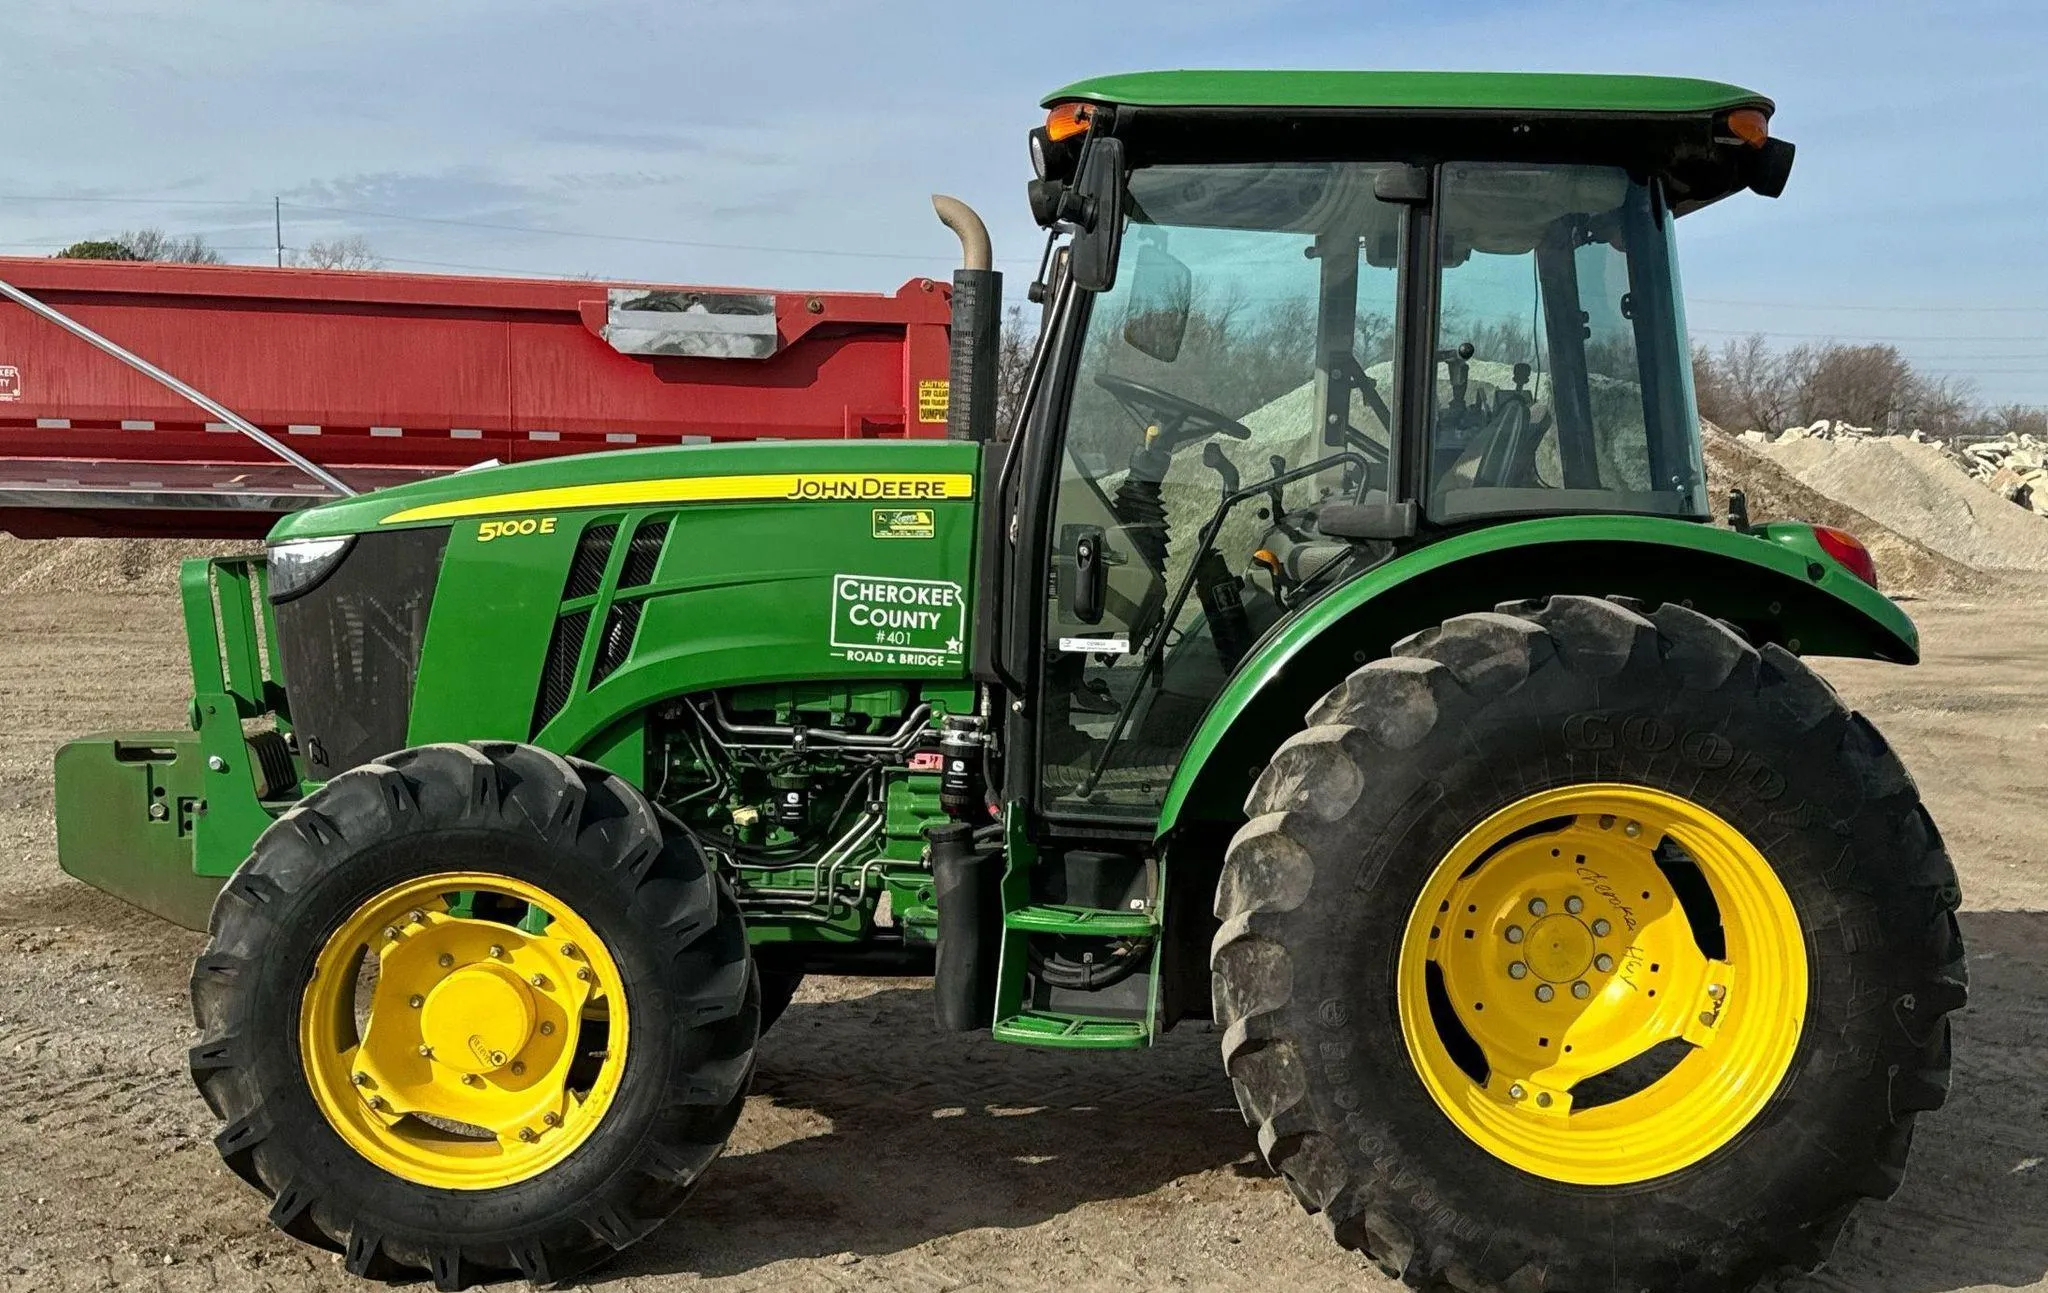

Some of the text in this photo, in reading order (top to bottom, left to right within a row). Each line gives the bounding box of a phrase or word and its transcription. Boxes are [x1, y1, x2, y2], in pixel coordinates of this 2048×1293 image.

[788, 478, 946, 497] JOHN DEERE
[477, 517, 558, 542] 5100 E
[840, 580, 954, 607] CHEROKEE
[849, 604, 941, 630] COUNTY
[875, 630, 911, 645] #401
[846, 650, 945, 667] ROAD & BRIDGE
